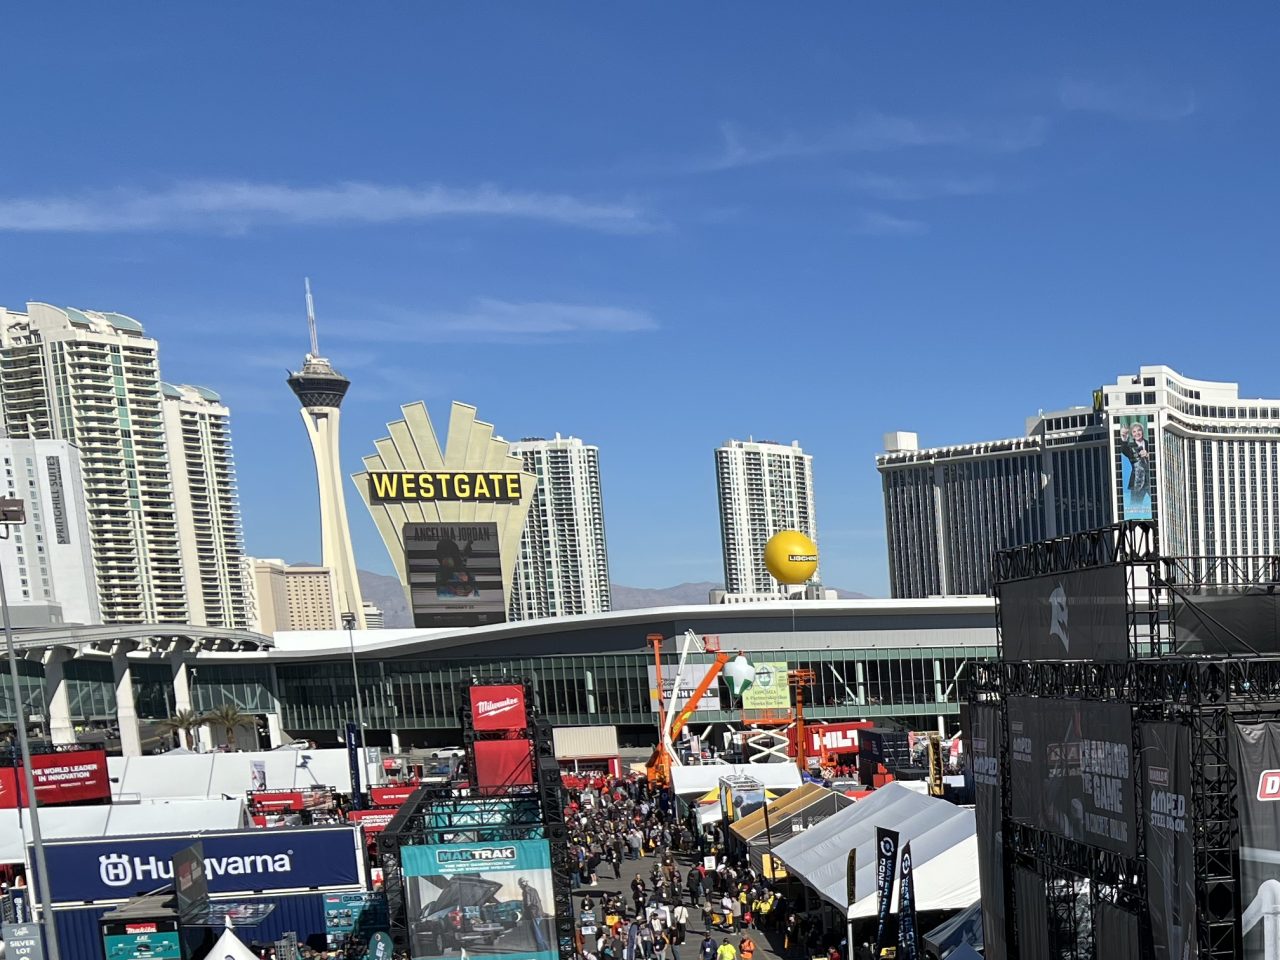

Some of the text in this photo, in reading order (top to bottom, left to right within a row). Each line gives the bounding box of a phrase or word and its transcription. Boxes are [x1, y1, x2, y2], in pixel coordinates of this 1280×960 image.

[47, 456, 59, 488] SUITES
[372, 473, 520, 498] WESTGATE
[51, 489, 66, 544] SPRINGHILL
[414, 527, 490, 542] ANGELINA JORDAN
[661, 689, 689, 698] NOTH
[476, 697, 519, 714] Milwaukee
[813, 729, 859, 751] HILT
[43, 766, 69, 775] WORLD
[70, 764, 98, 772] LEADER
[48, 771, 90, 781] INNOVATION
[133, 854, 291, 881] Huqvarna
[9, 939, 35, 948] SILVER
